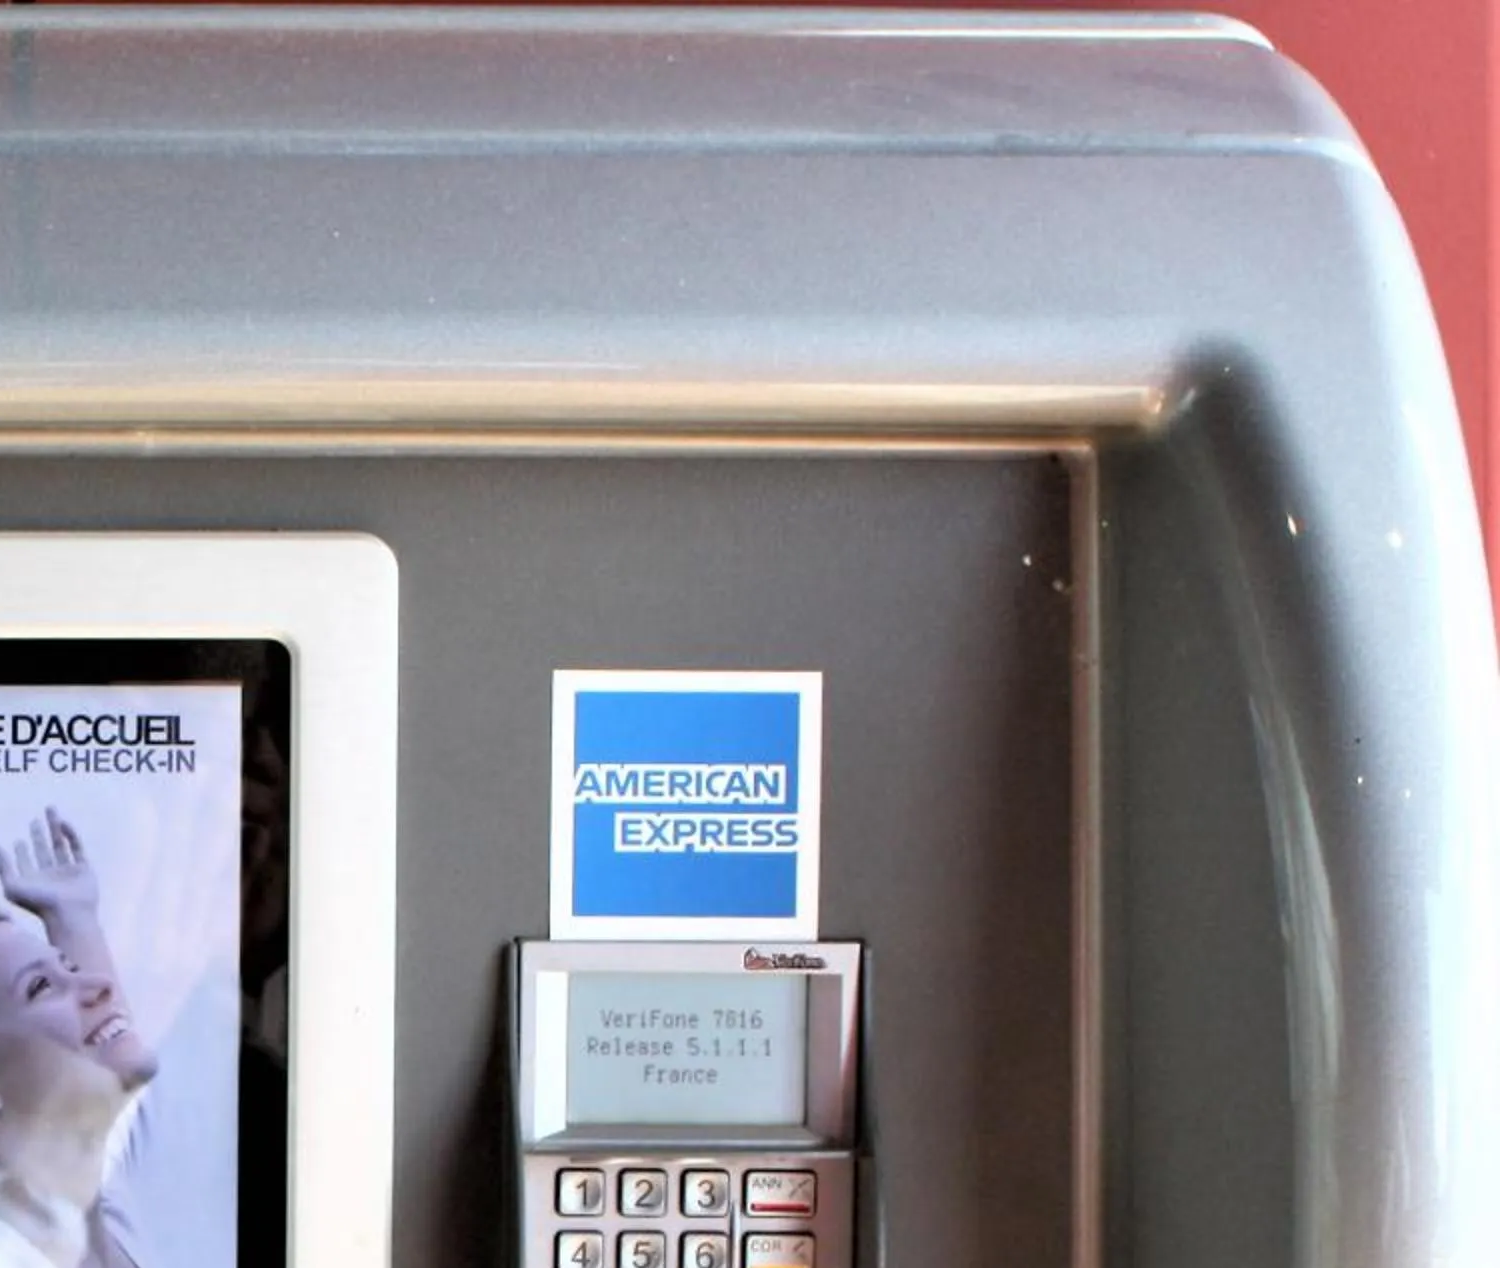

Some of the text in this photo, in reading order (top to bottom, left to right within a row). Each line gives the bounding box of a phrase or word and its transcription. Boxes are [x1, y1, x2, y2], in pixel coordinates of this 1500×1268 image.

[11, 714, 195, 745] D'ACCUEIL
[49, 749, 195, 773] CHECK-IN
[575, 770, 780, 797] AMERICAN
[620, 819, 798, 847] EXPRESS
[586, 1037, 772, 1057] Release 5.1.1.1
[643, 1064, 718, 1084] France
[576, 1179, 716, 1207] 1 2 3
[571, 1241, 591, 1268] 4
[633, 1241, 652, 1268] 5
